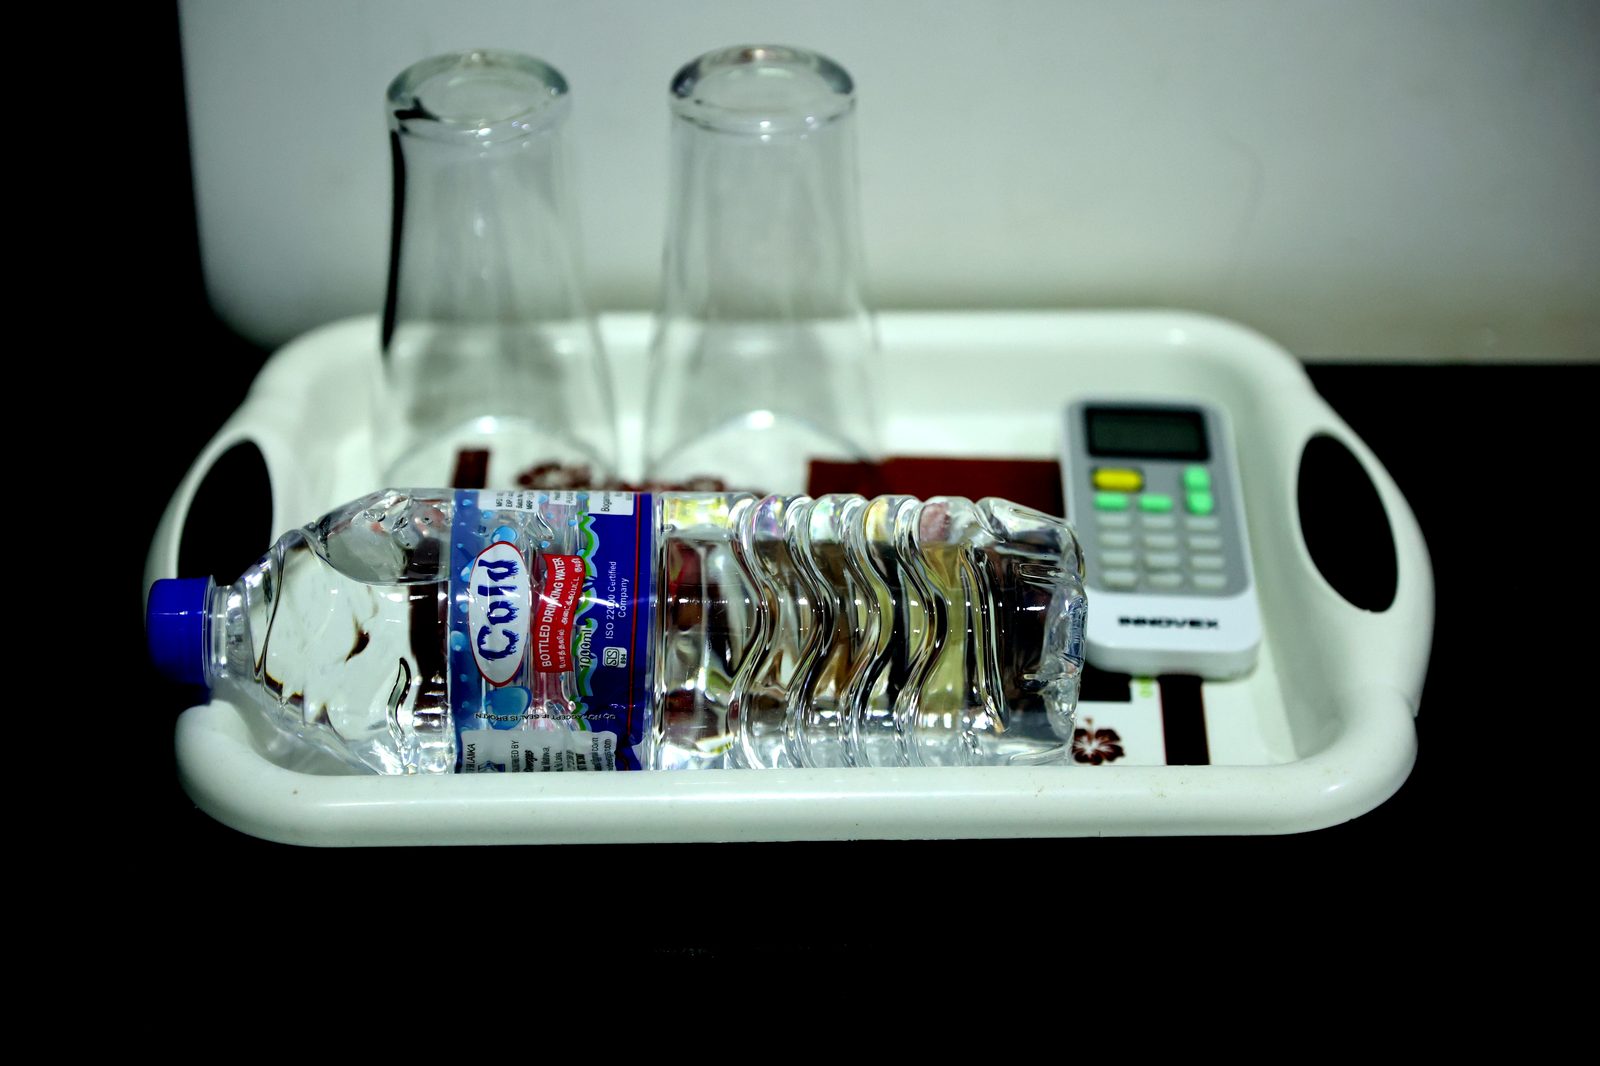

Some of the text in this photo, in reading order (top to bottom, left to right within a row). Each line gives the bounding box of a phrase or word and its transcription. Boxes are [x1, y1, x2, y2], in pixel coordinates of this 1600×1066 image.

[477, 559, 519, 661] Cold
[538, 557, 566, 667] BOTTLED DRINKING WATER
[605, 561, 617, 639] ISO 22000 Certified
[618, 578, 629, 618] Company
[579, 629, 592, 669] 1000ml
[475, 713, 508, 721] BROKEN
[511, 740, 519, 749] BY
